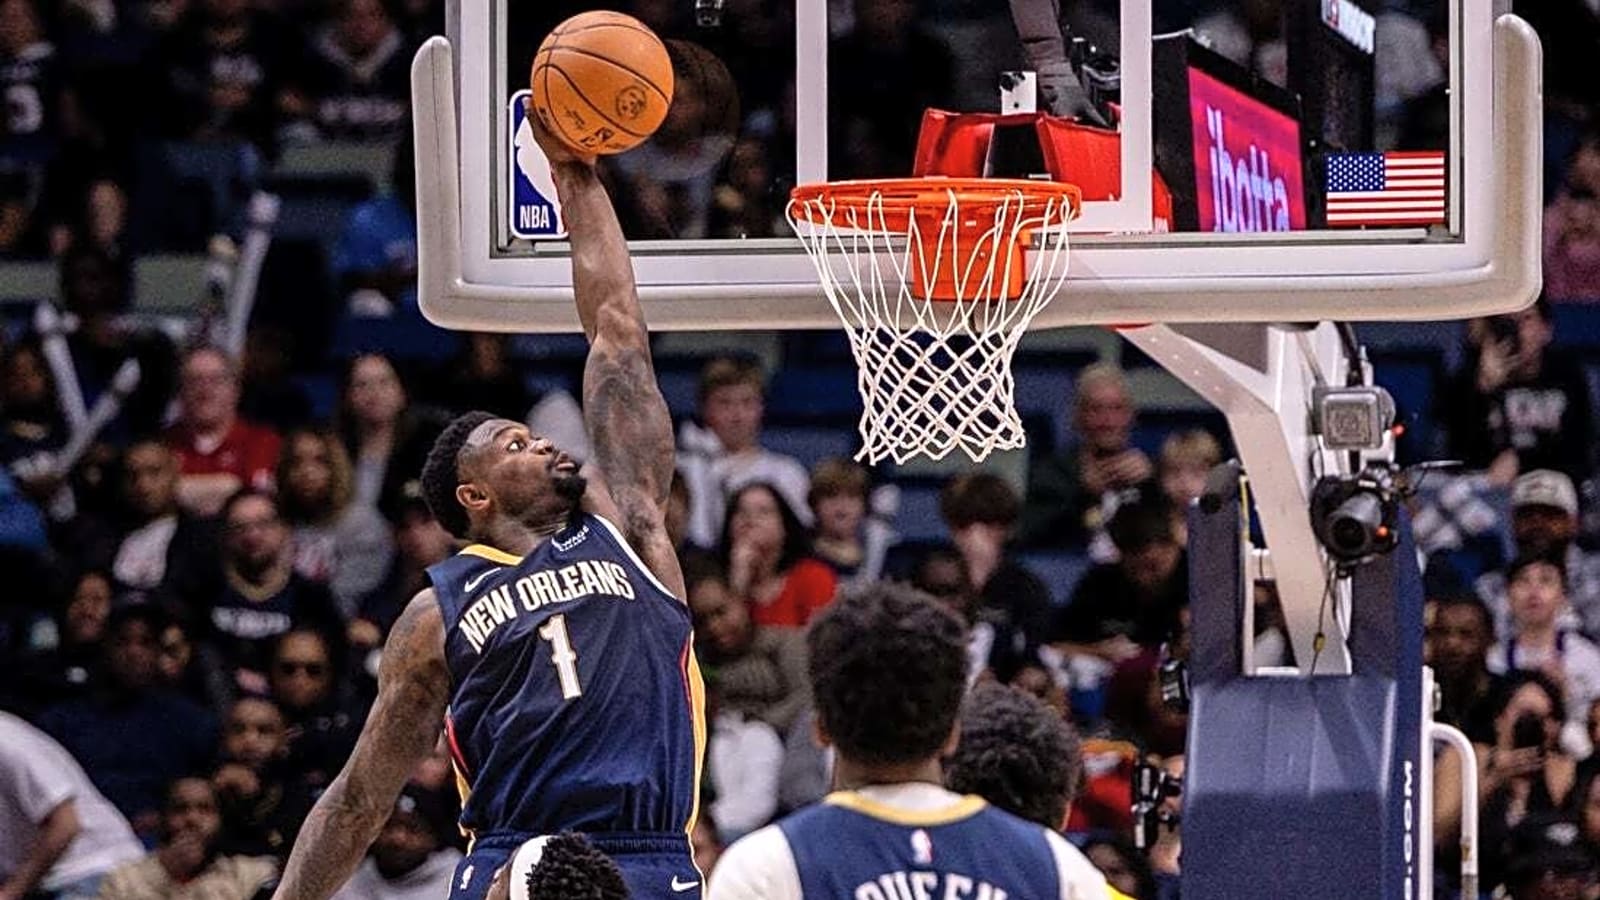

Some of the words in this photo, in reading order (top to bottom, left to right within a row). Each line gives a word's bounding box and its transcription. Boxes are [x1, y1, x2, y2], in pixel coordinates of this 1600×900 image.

[520, 204, 551, 229] NBA
[458, 584, 518, 655] NEW
[515, 559, 636, 612] ORLEANS
[538, 612, 583, 700] 1
